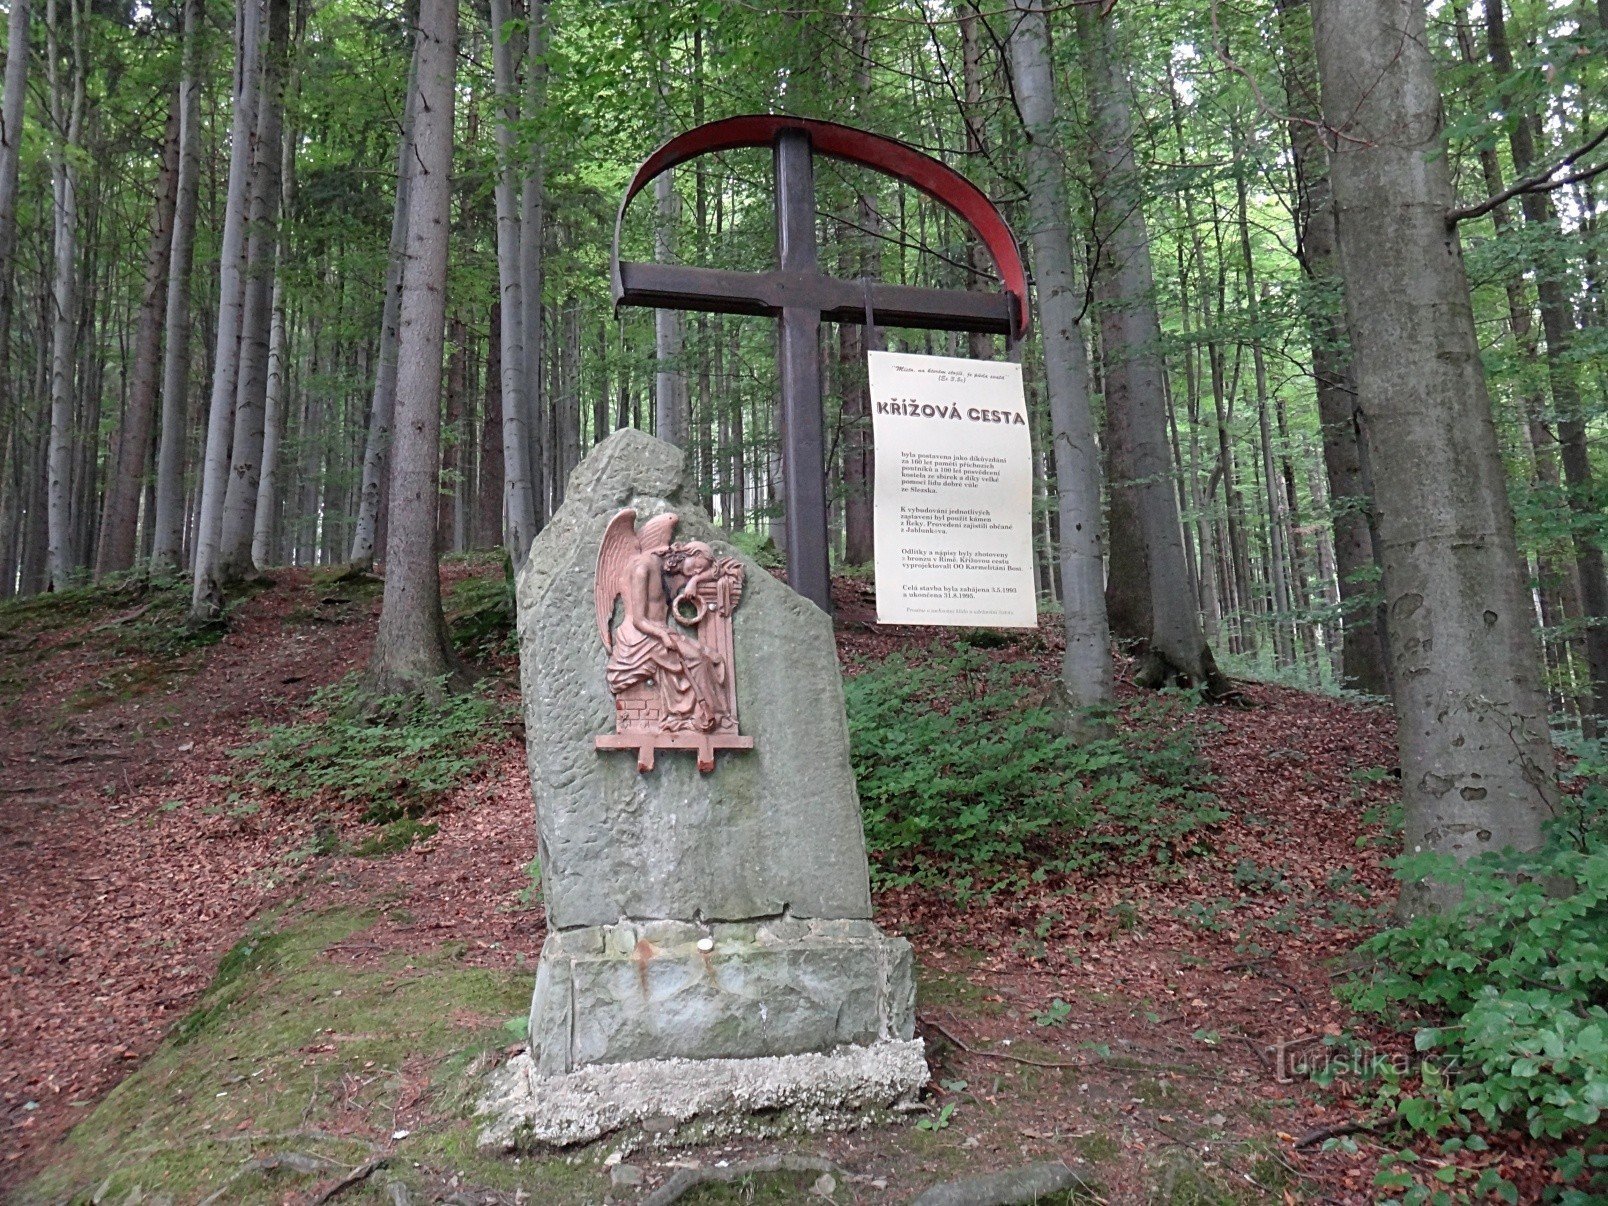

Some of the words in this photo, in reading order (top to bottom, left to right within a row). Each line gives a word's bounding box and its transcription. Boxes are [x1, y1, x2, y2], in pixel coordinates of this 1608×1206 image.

[876, 397, 962, 420] KŘÍŽOVÁ
[967, 408, 1026, 426] CESTA
[901, 451, 916, 459] byla
[952, 454, 968, 462] jako
[910, 486, 938, 494] Slezska.
[907, 506, 947, 514] vybudování
[947, 508, 991, 516] jednotlivých
[963, 522, 988, 530] zajistili
[901, 548, 927, 556] Odlitky
[958, 550, 972, 559] byly
[974, 551, 1009, 559] zhotoveny
[902, 562, 952, 570] vyprojektovali
[943, 585, 959, 593] byla
[959, 586, 990, 594] zahájena
